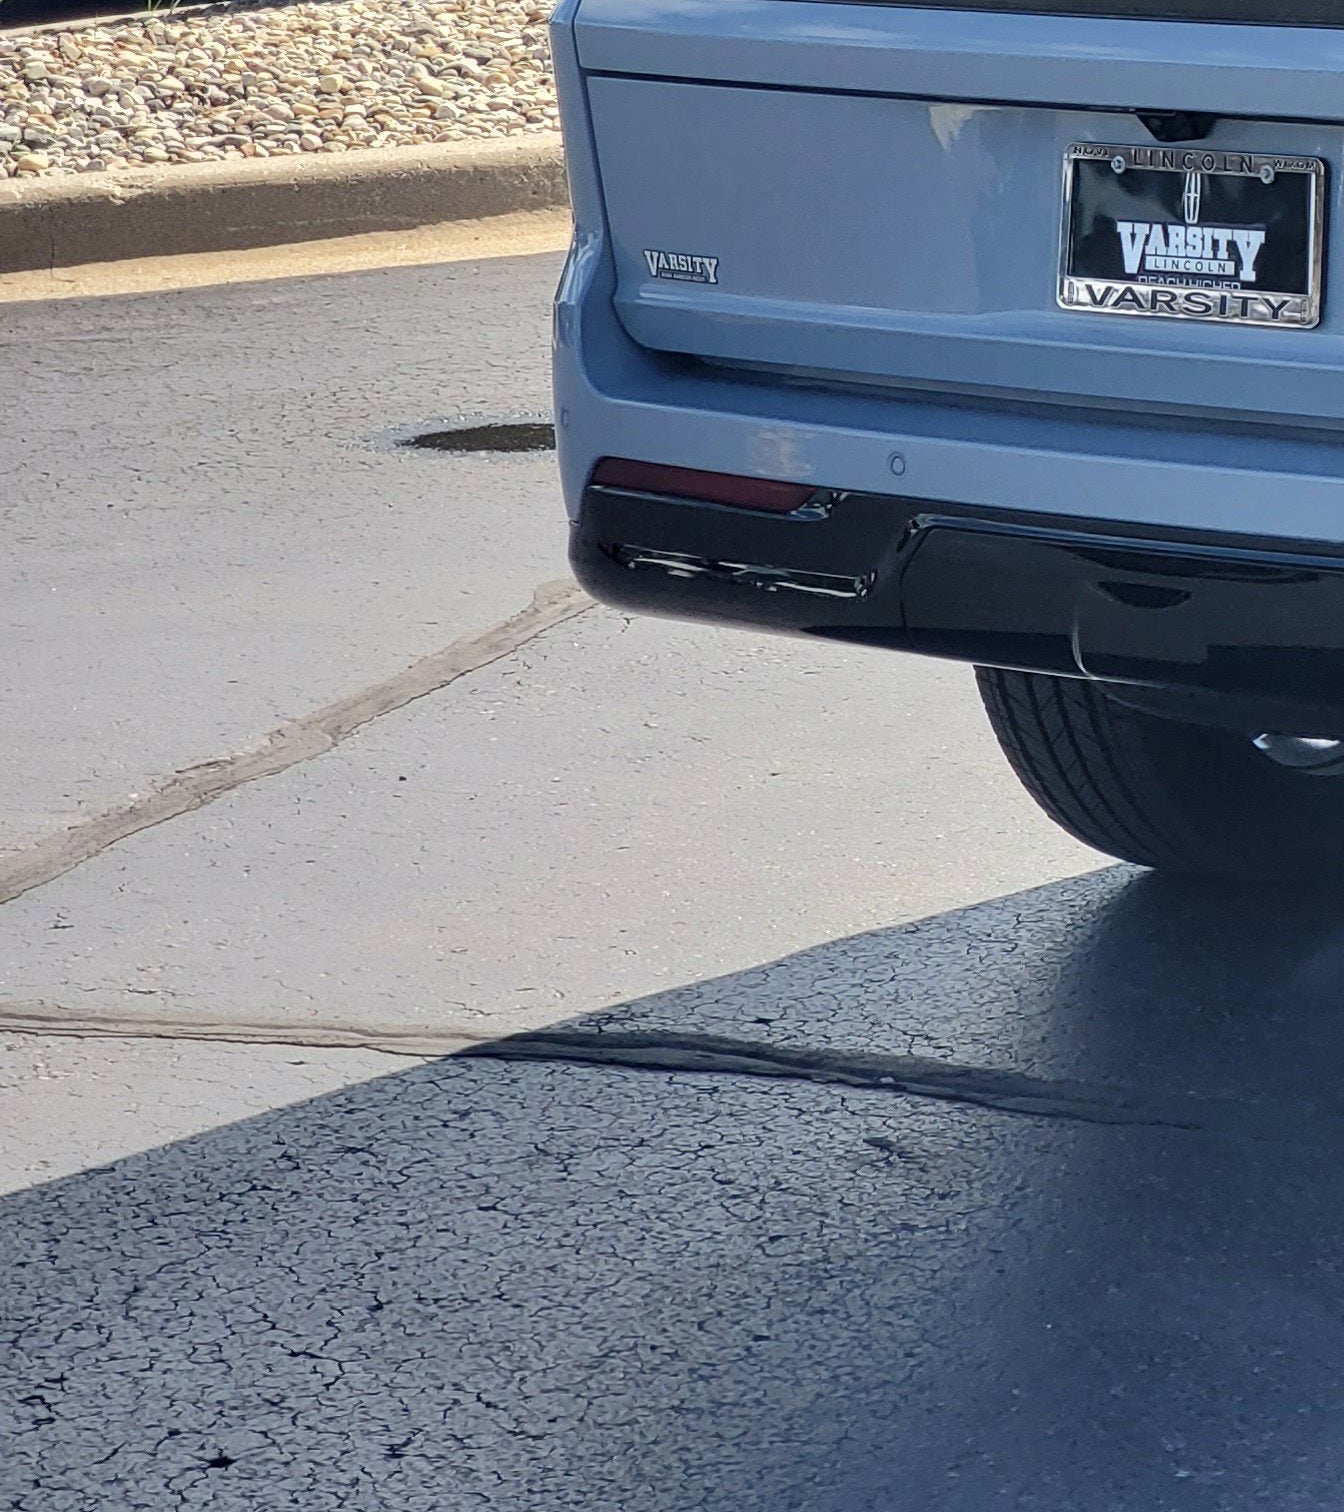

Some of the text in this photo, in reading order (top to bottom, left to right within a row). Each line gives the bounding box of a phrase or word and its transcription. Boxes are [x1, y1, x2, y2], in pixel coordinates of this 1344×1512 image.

[1132, 148, 1254, 174] LINCOLN
[644, 250, 718, 284] VARSITY
[1116, 221, 1266, 282] VARSITY
[1153, 259, 1227, 273] LINCOLN
[1085, 284, 1291, 320] VARSITY
